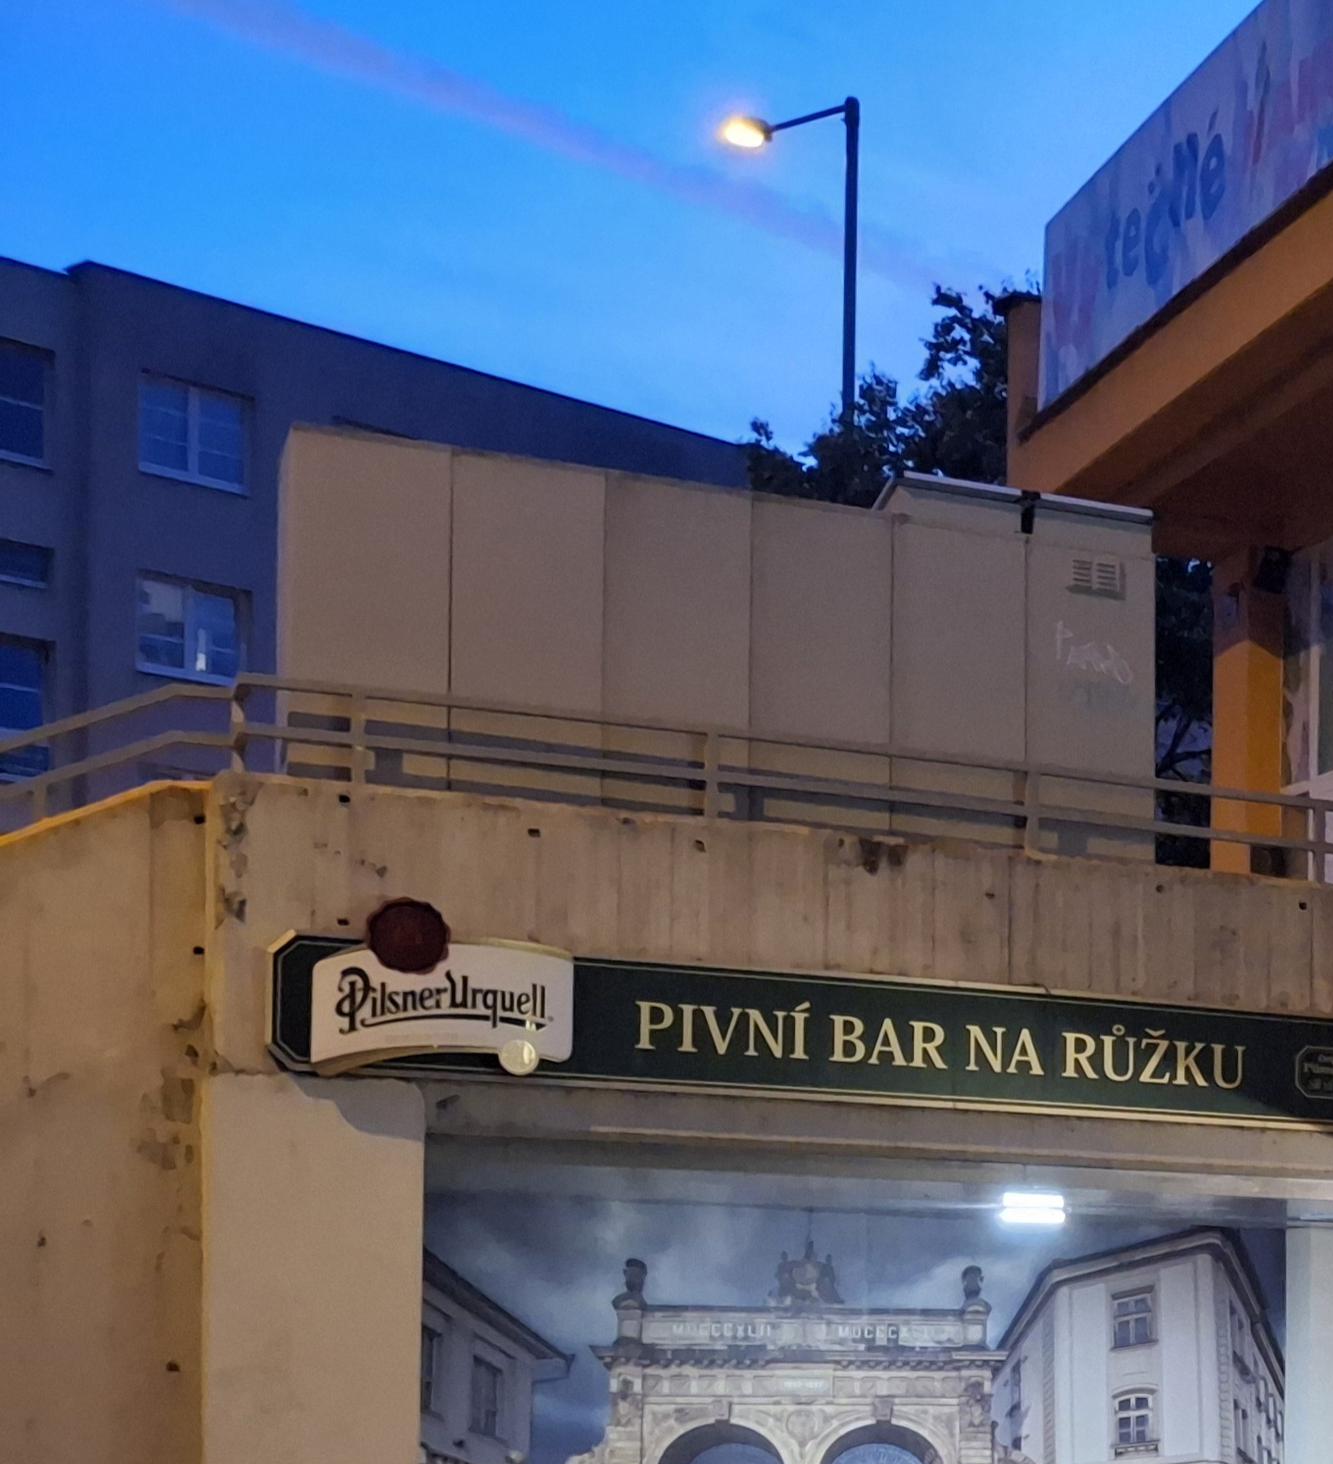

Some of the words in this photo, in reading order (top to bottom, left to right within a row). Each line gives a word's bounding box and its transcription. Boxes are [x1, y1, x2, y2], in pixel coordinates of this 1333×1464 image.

[334, 965, 449, 1035] Pilsner
[445, 969, 548, 1029] Urquell
[634, 1000, 812, 1060] PIVNÍ
[828, 1014, 948, 1070] BAR
[964, 1023, 1045, 1076] NA
[1060, 1022, 1247, 1090] RŮŽKU
